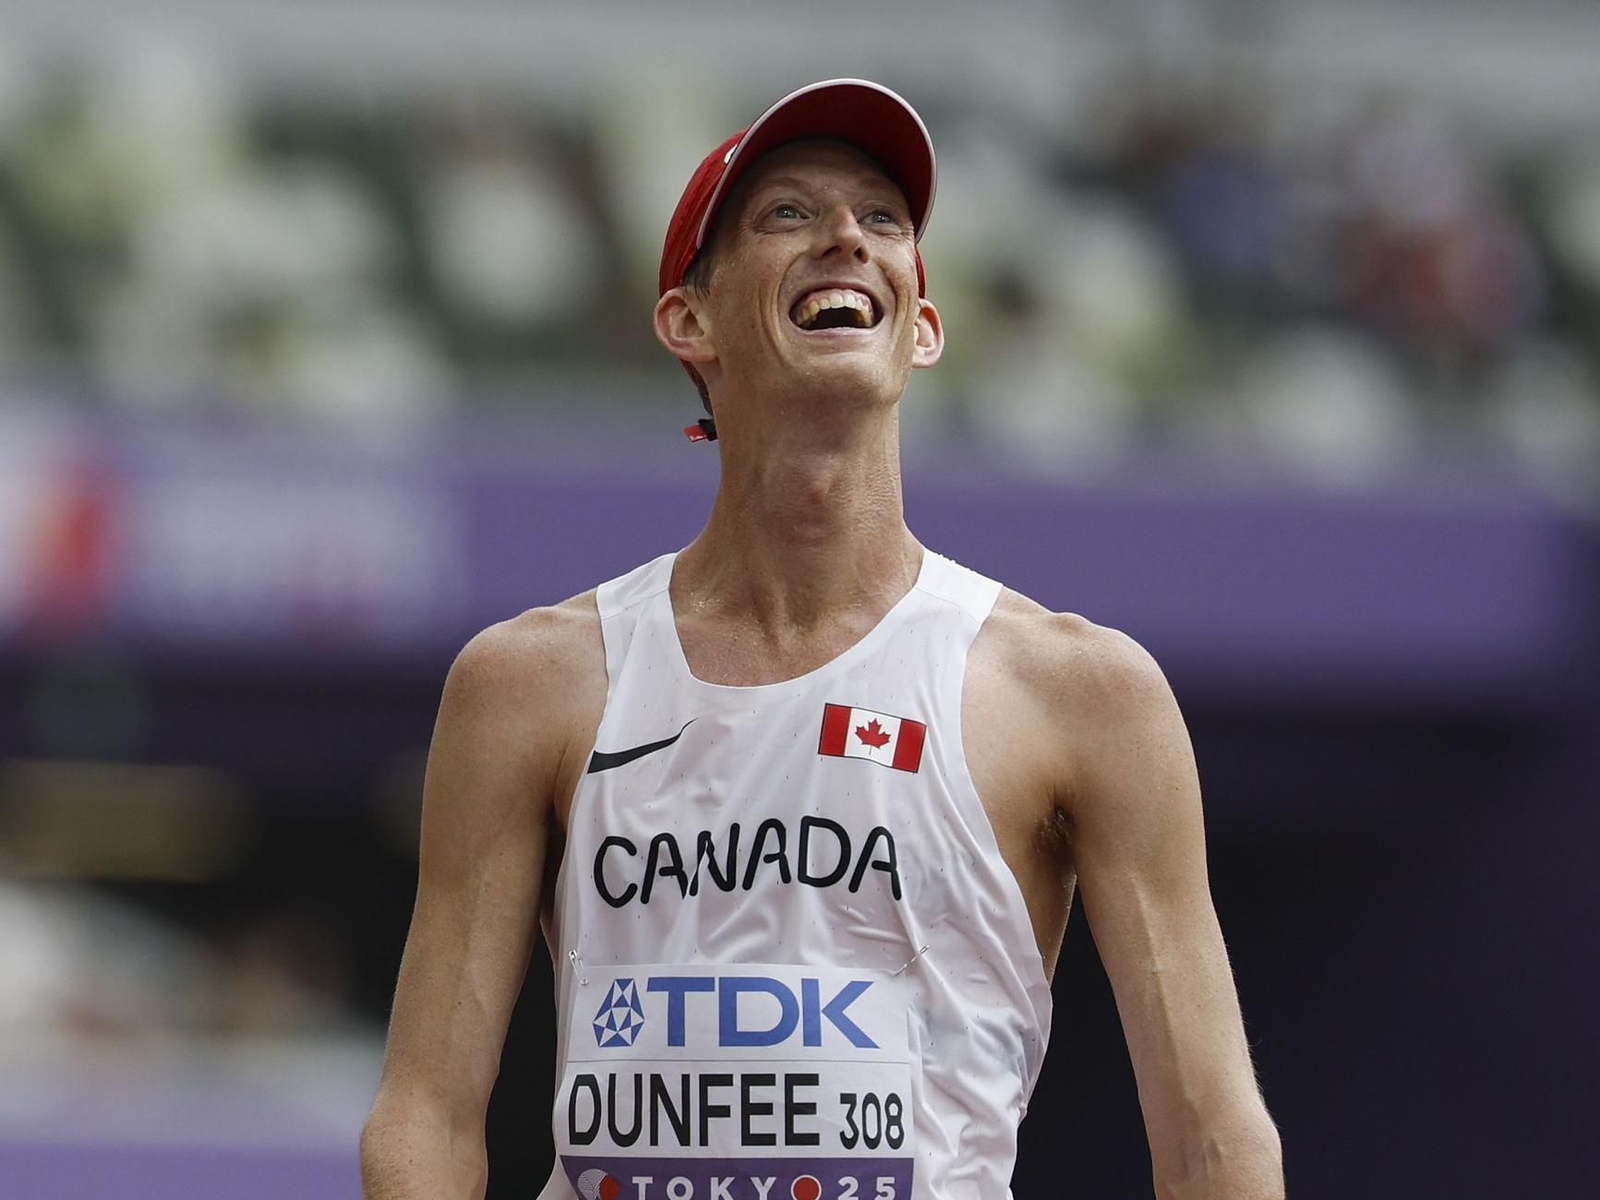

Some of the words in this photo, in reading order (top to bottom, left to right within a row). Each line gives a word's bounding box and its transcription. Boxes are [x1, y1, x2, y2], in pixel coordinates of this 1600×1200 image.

[593, 815, 902, 908] CANADA
[646, 976, 881, 1049] TDK
[568, 1073, 820, 1148] DUNFEE
[839, 1092, 905, 1151] 308
